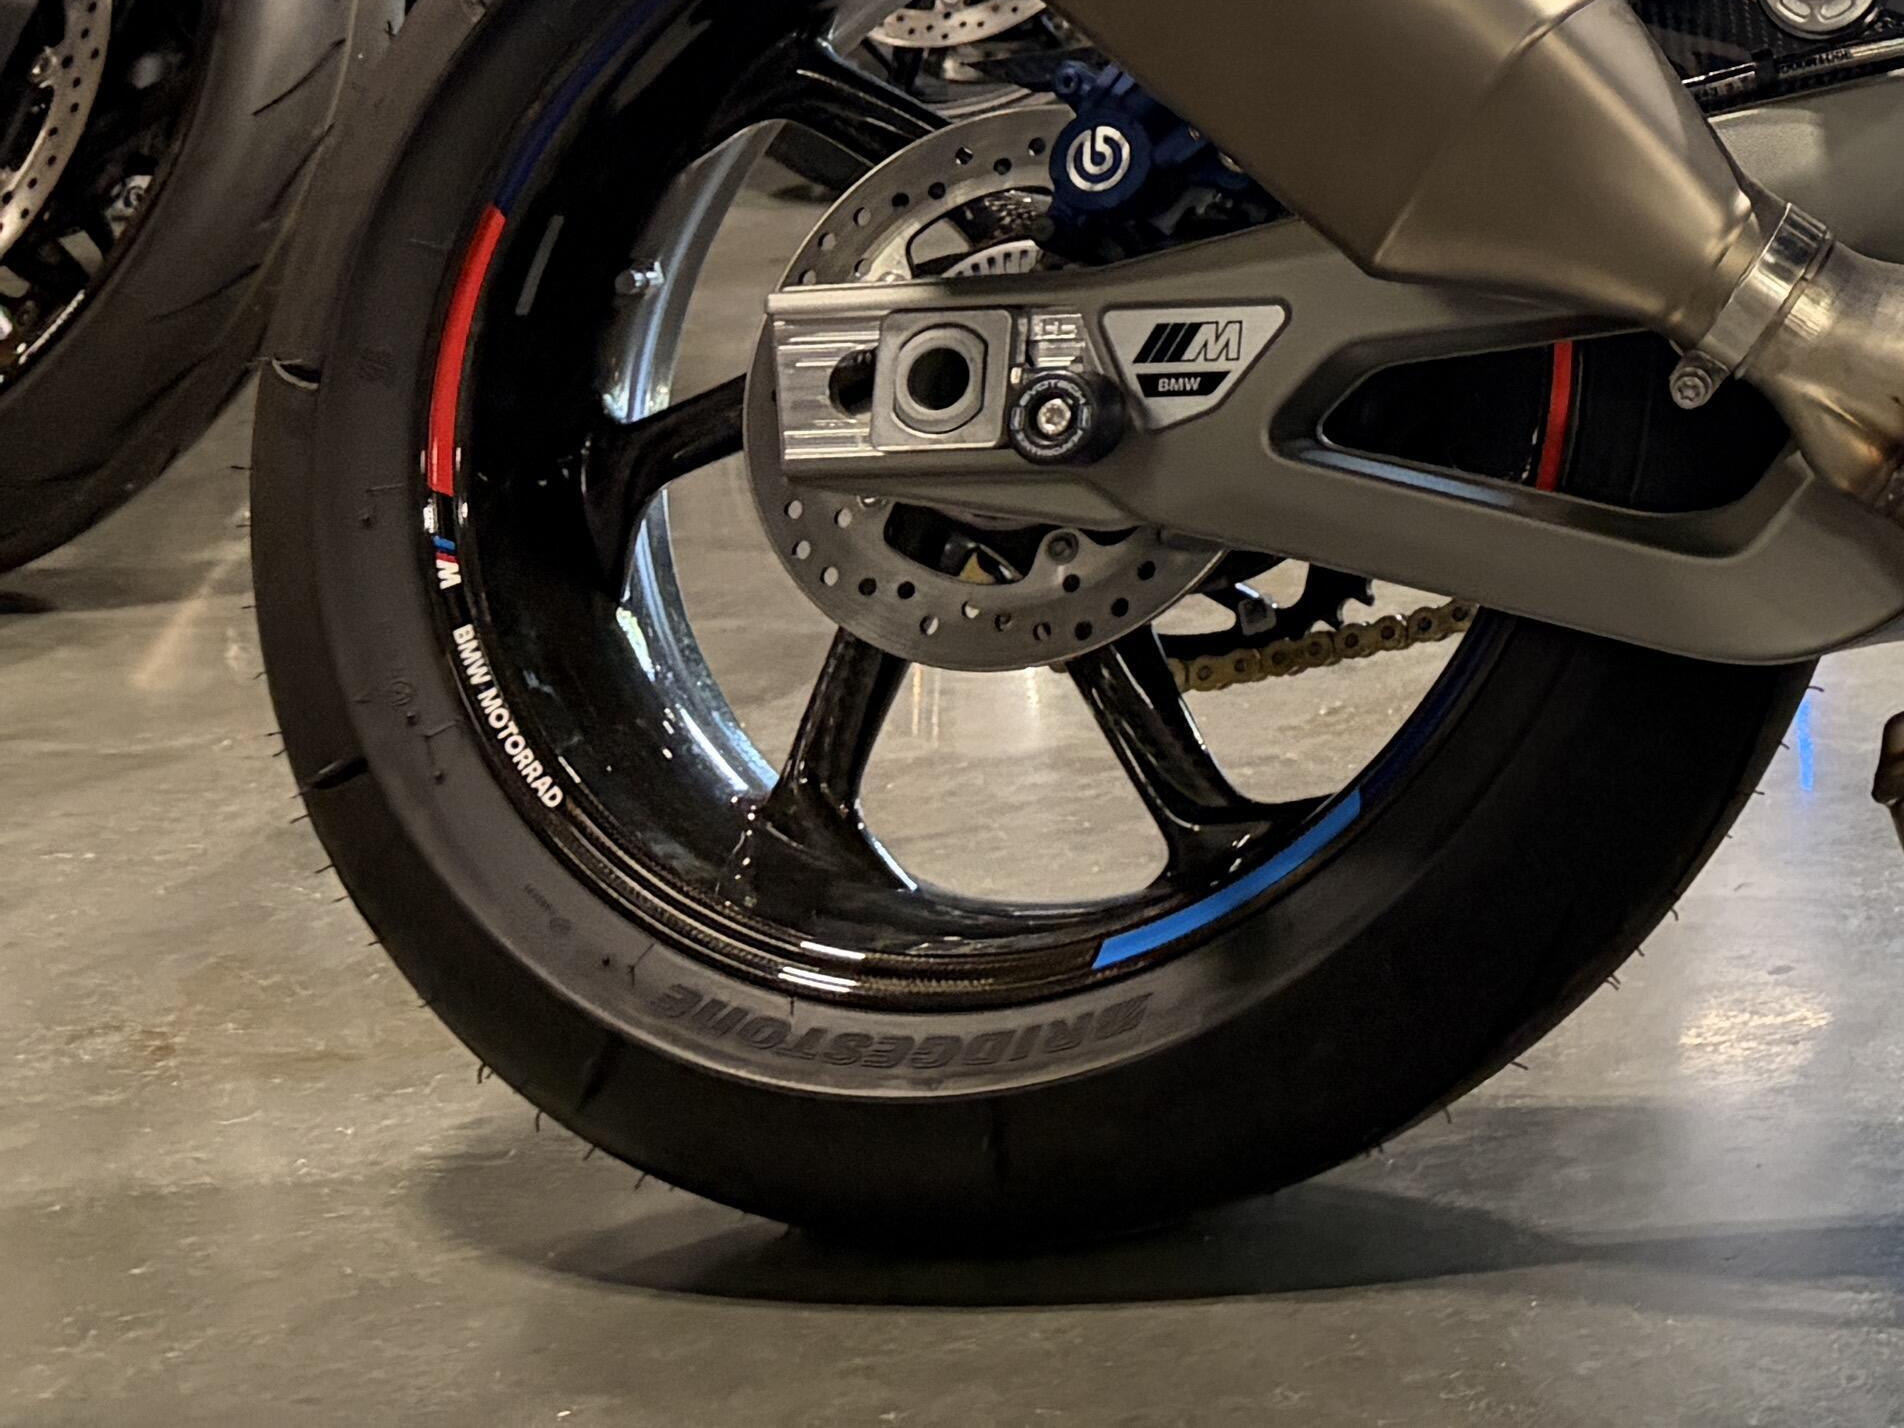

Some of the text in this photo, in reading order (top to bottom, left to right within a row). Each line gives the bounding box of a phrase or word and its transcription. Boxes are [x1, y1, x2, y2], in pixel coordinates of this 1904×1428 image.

[1157, 377, 1202, 392] BMW
[452, 623, 493, 686] BMW
[477, 686, 564, 808] MOTORRAD
